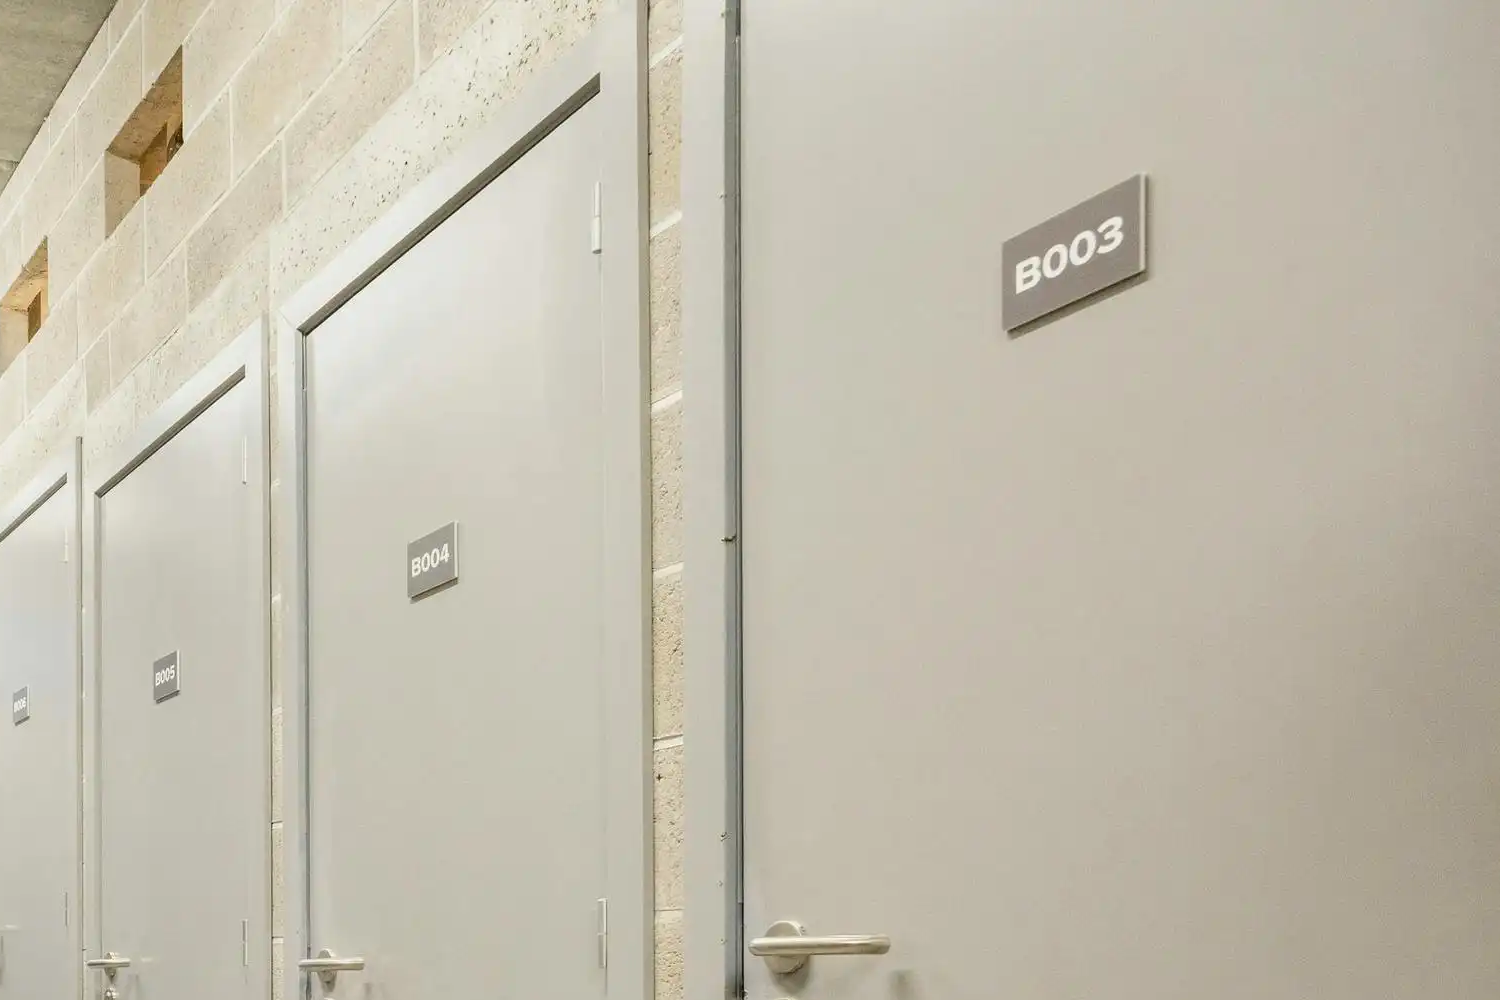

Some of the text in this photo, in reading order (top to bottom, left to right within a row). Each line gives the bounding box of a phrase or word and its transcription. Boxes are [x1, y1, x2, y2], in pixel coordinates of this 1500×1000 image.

[1015, 215, 1124, 295] B003
[411, 543, 450, 578] B004
[155, 664, 176, 687] B005
